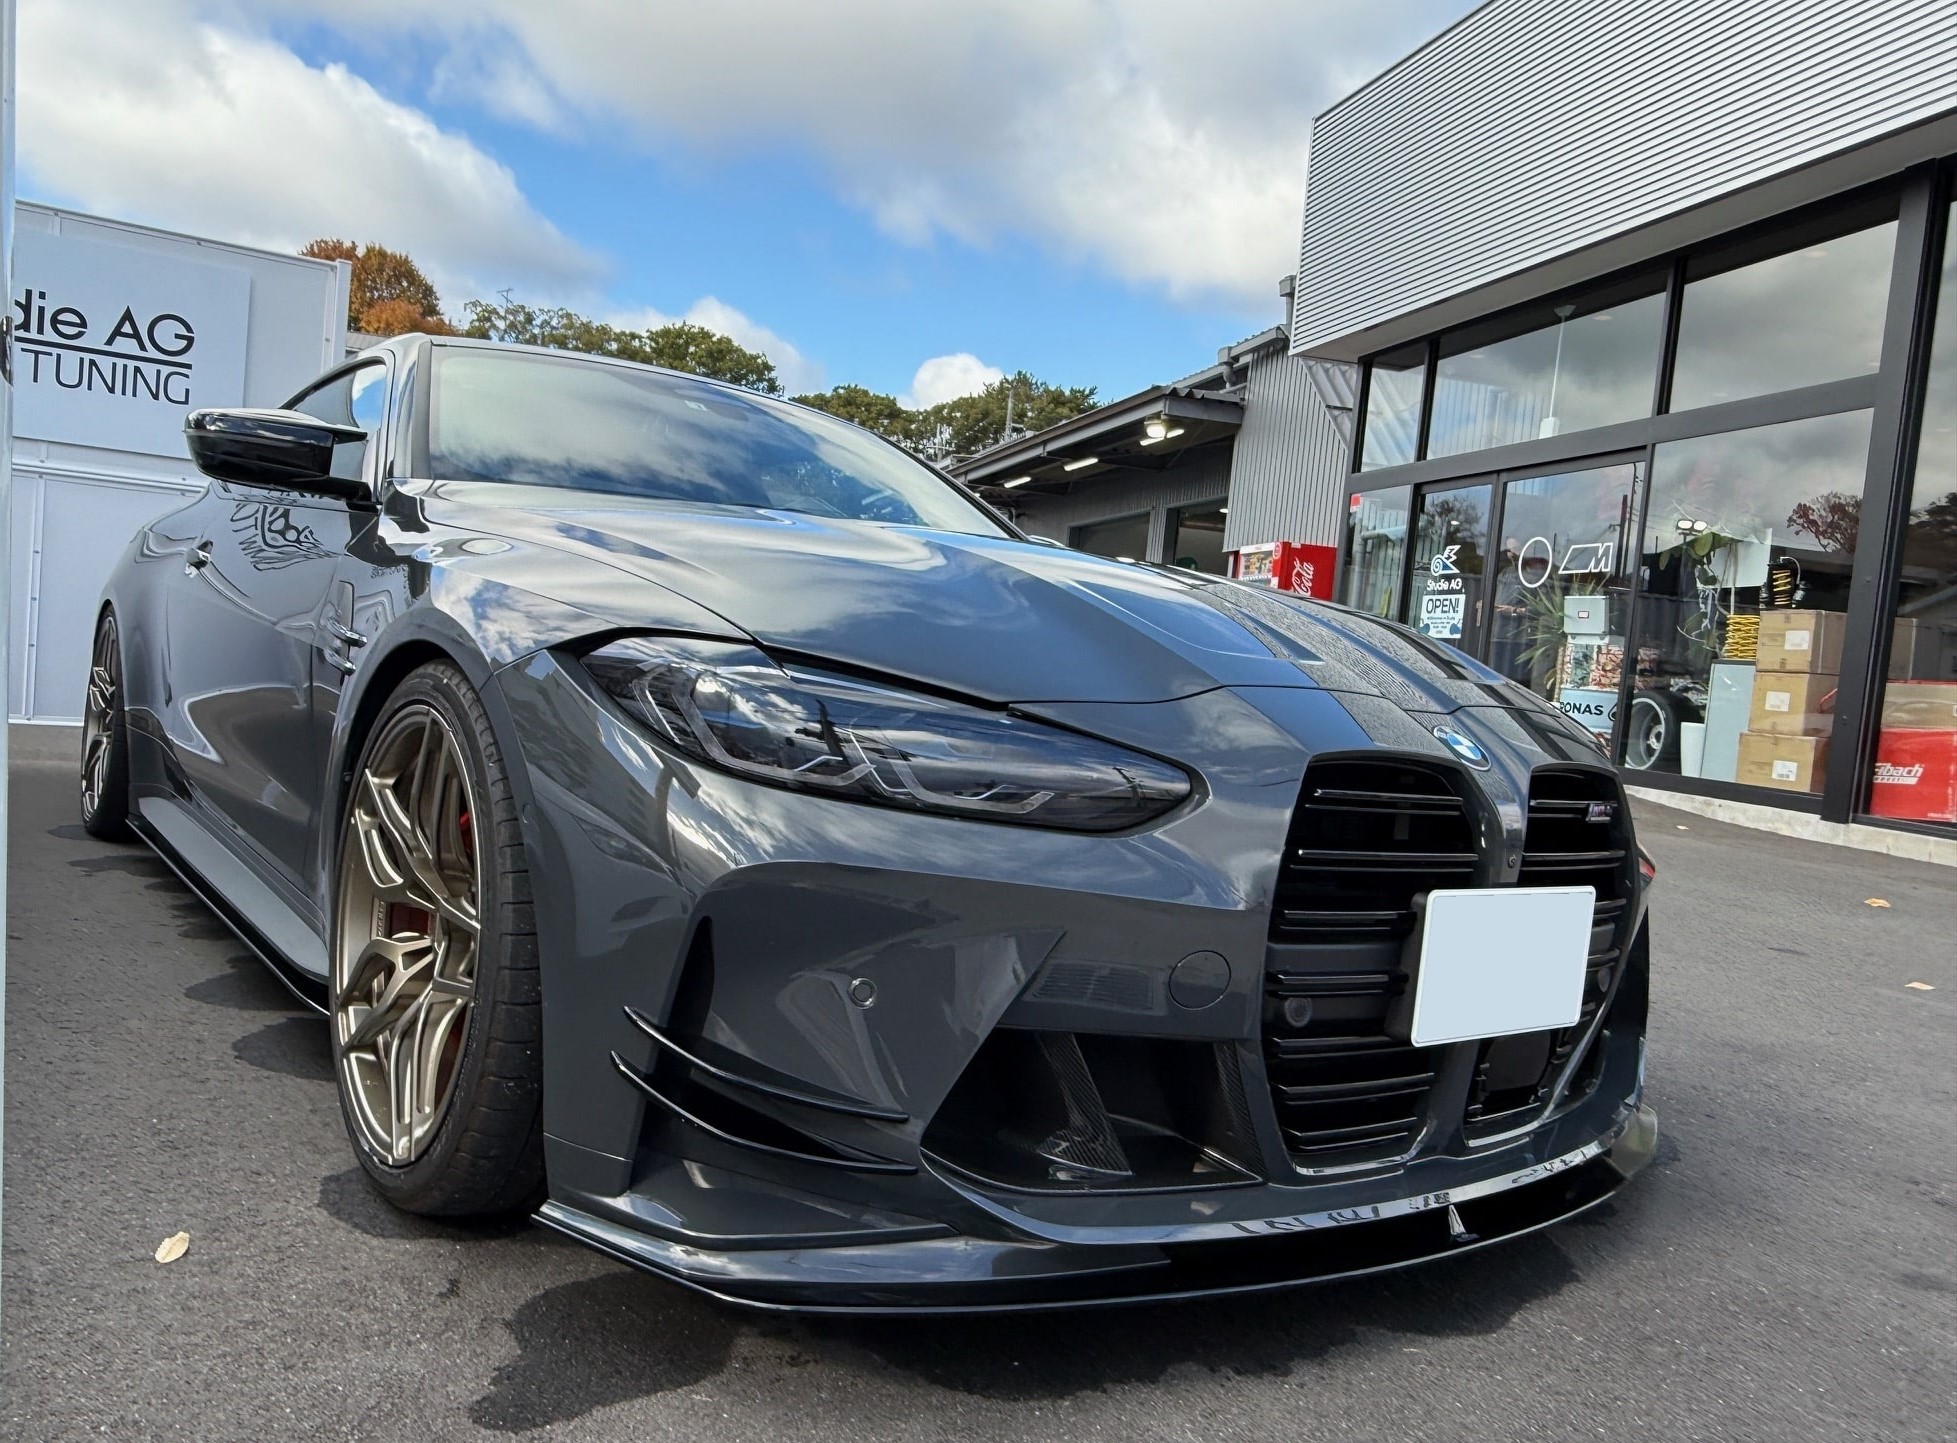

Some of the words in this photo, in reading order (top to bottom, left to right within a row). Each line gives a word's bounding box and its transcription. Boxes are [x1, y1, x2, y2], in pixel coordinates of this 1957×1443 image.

[104, 305, 195, 357] AG
[21, 347, 190, 405] TUNING
[1292, 557, 1315, 597] Cola
[1450, 578, 1462, 590] AG
[1426, 598, 1459, 614] OPEN!
